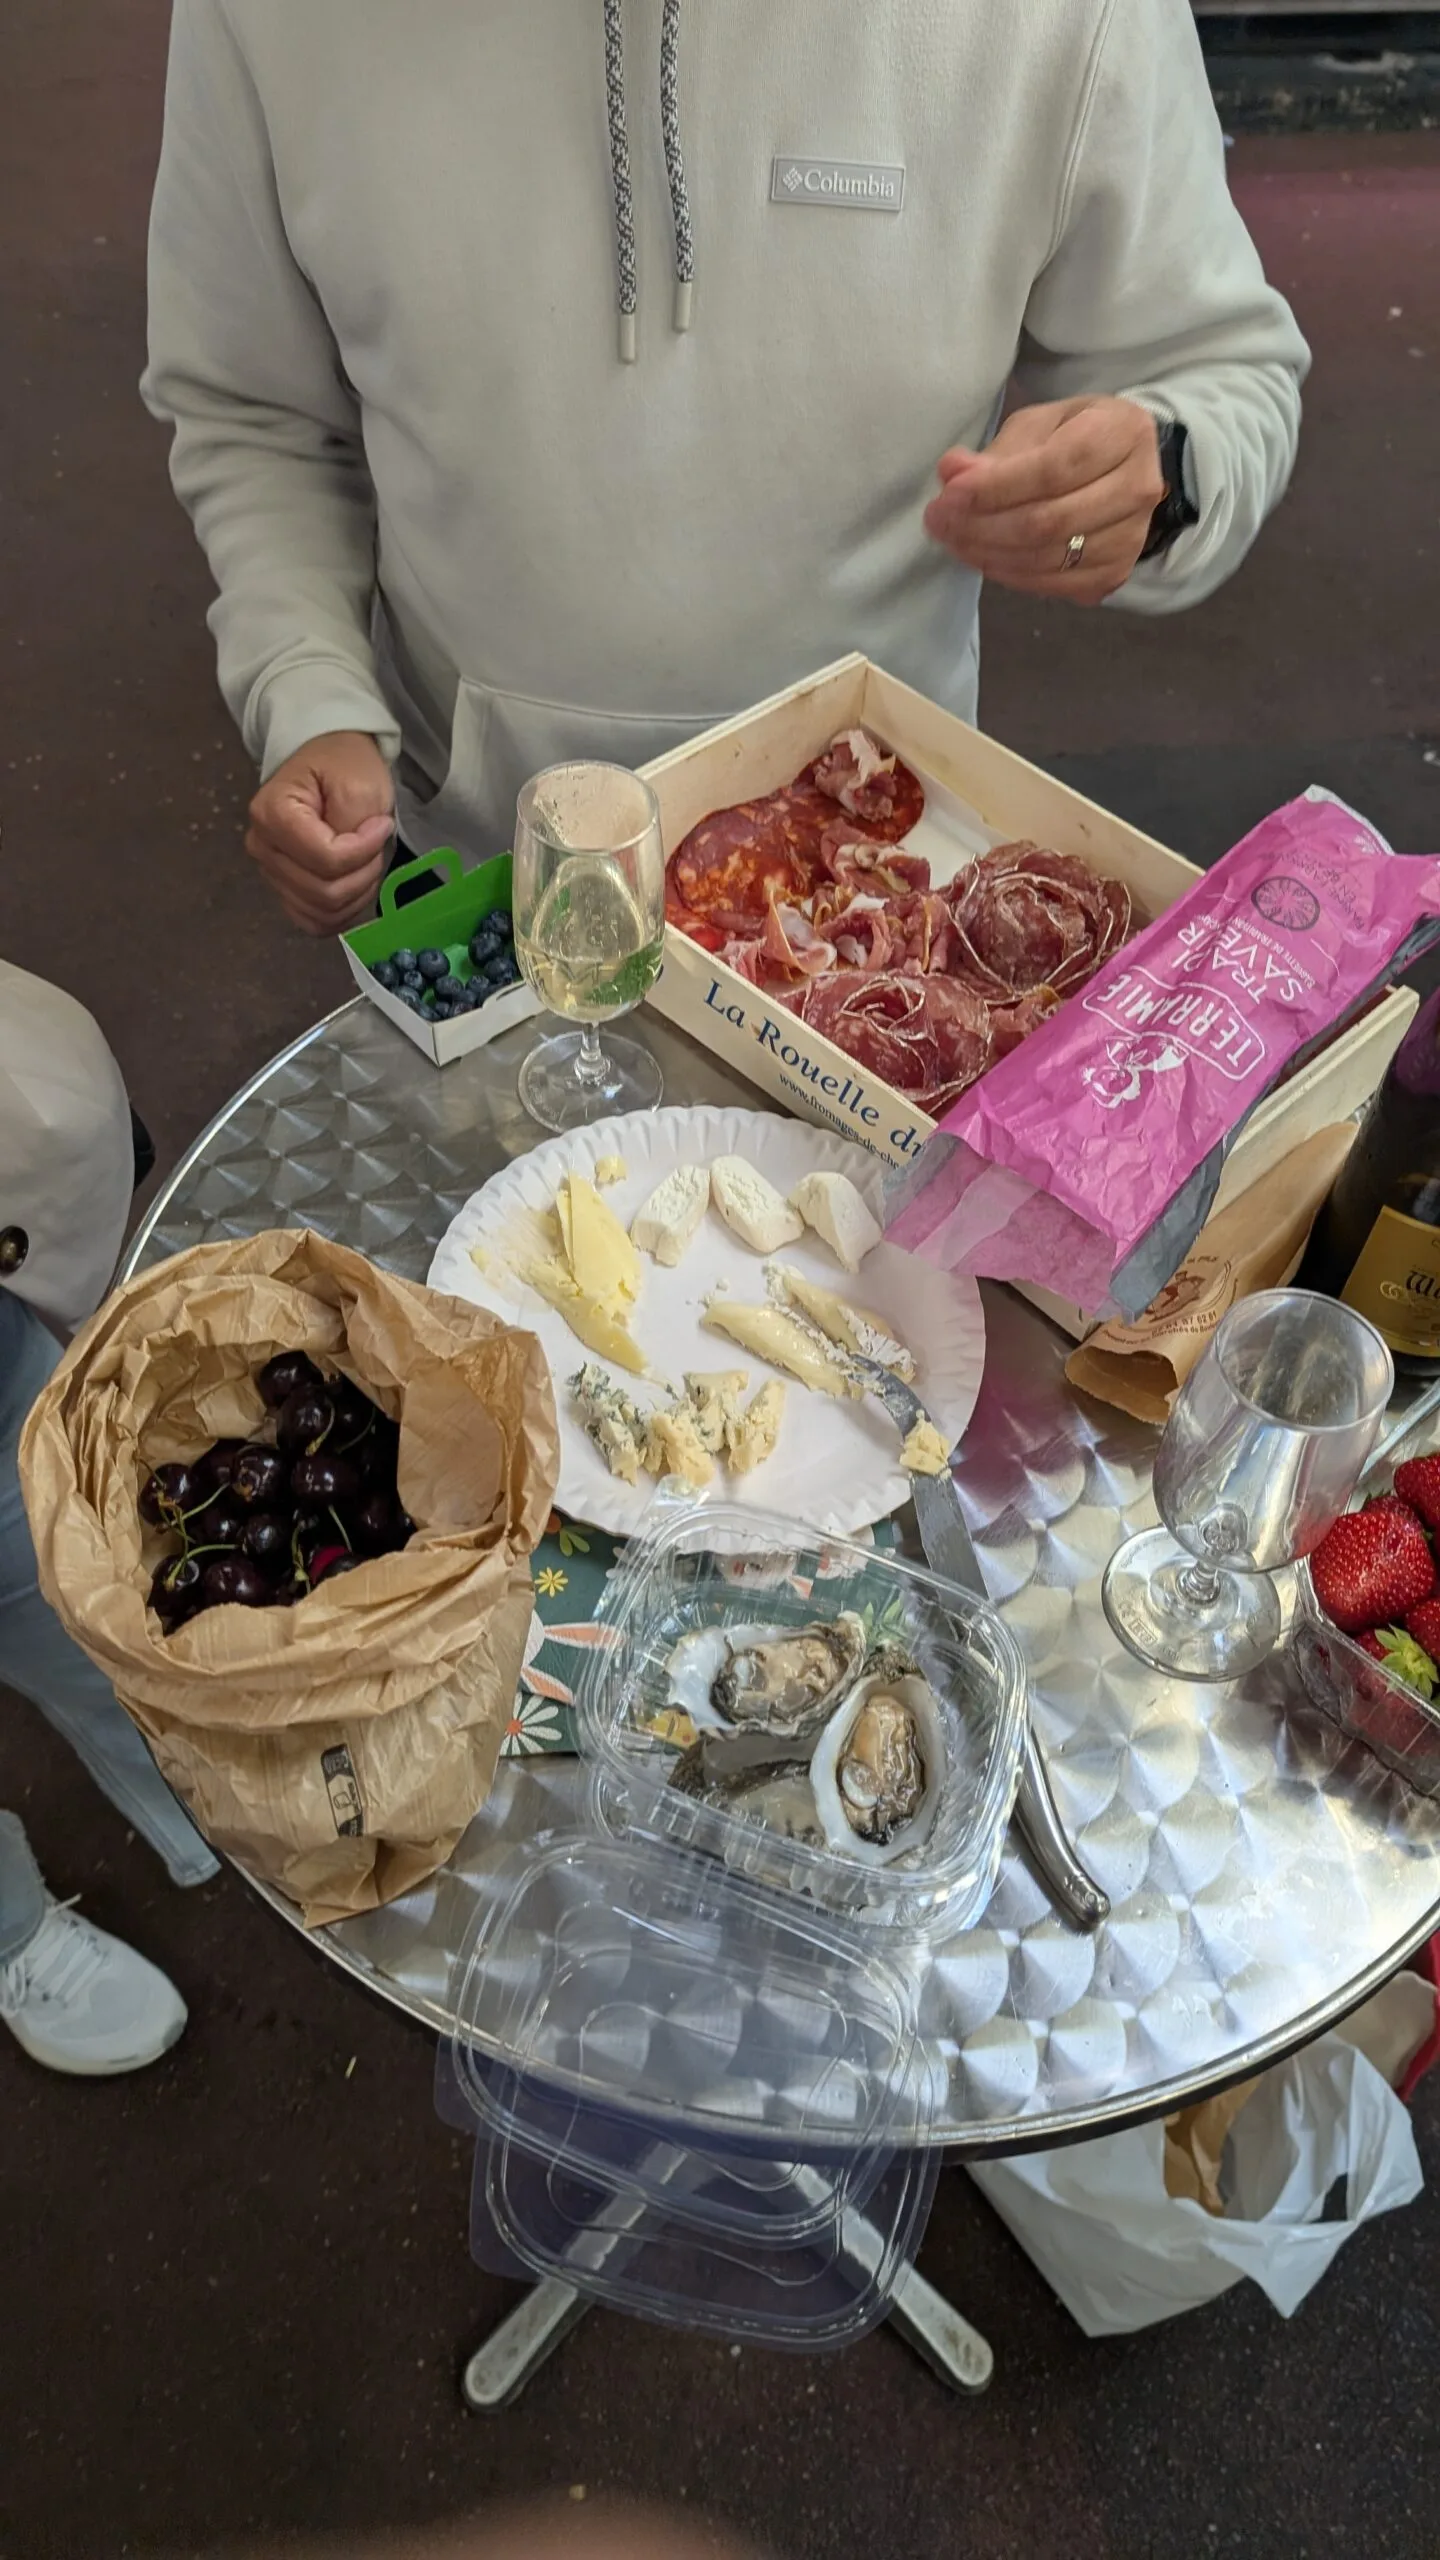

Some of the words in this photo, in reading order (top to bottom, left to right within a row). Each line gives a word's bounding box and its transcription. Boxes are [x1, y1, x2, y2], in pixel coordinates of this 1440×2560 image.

[804, 169, 894, 198] Columbia
[703, 978, 744, 1029] La
[755, 1016, 880, 1127] Rouelle
[1097, 973, 1252, 1067] TERRAMIE
